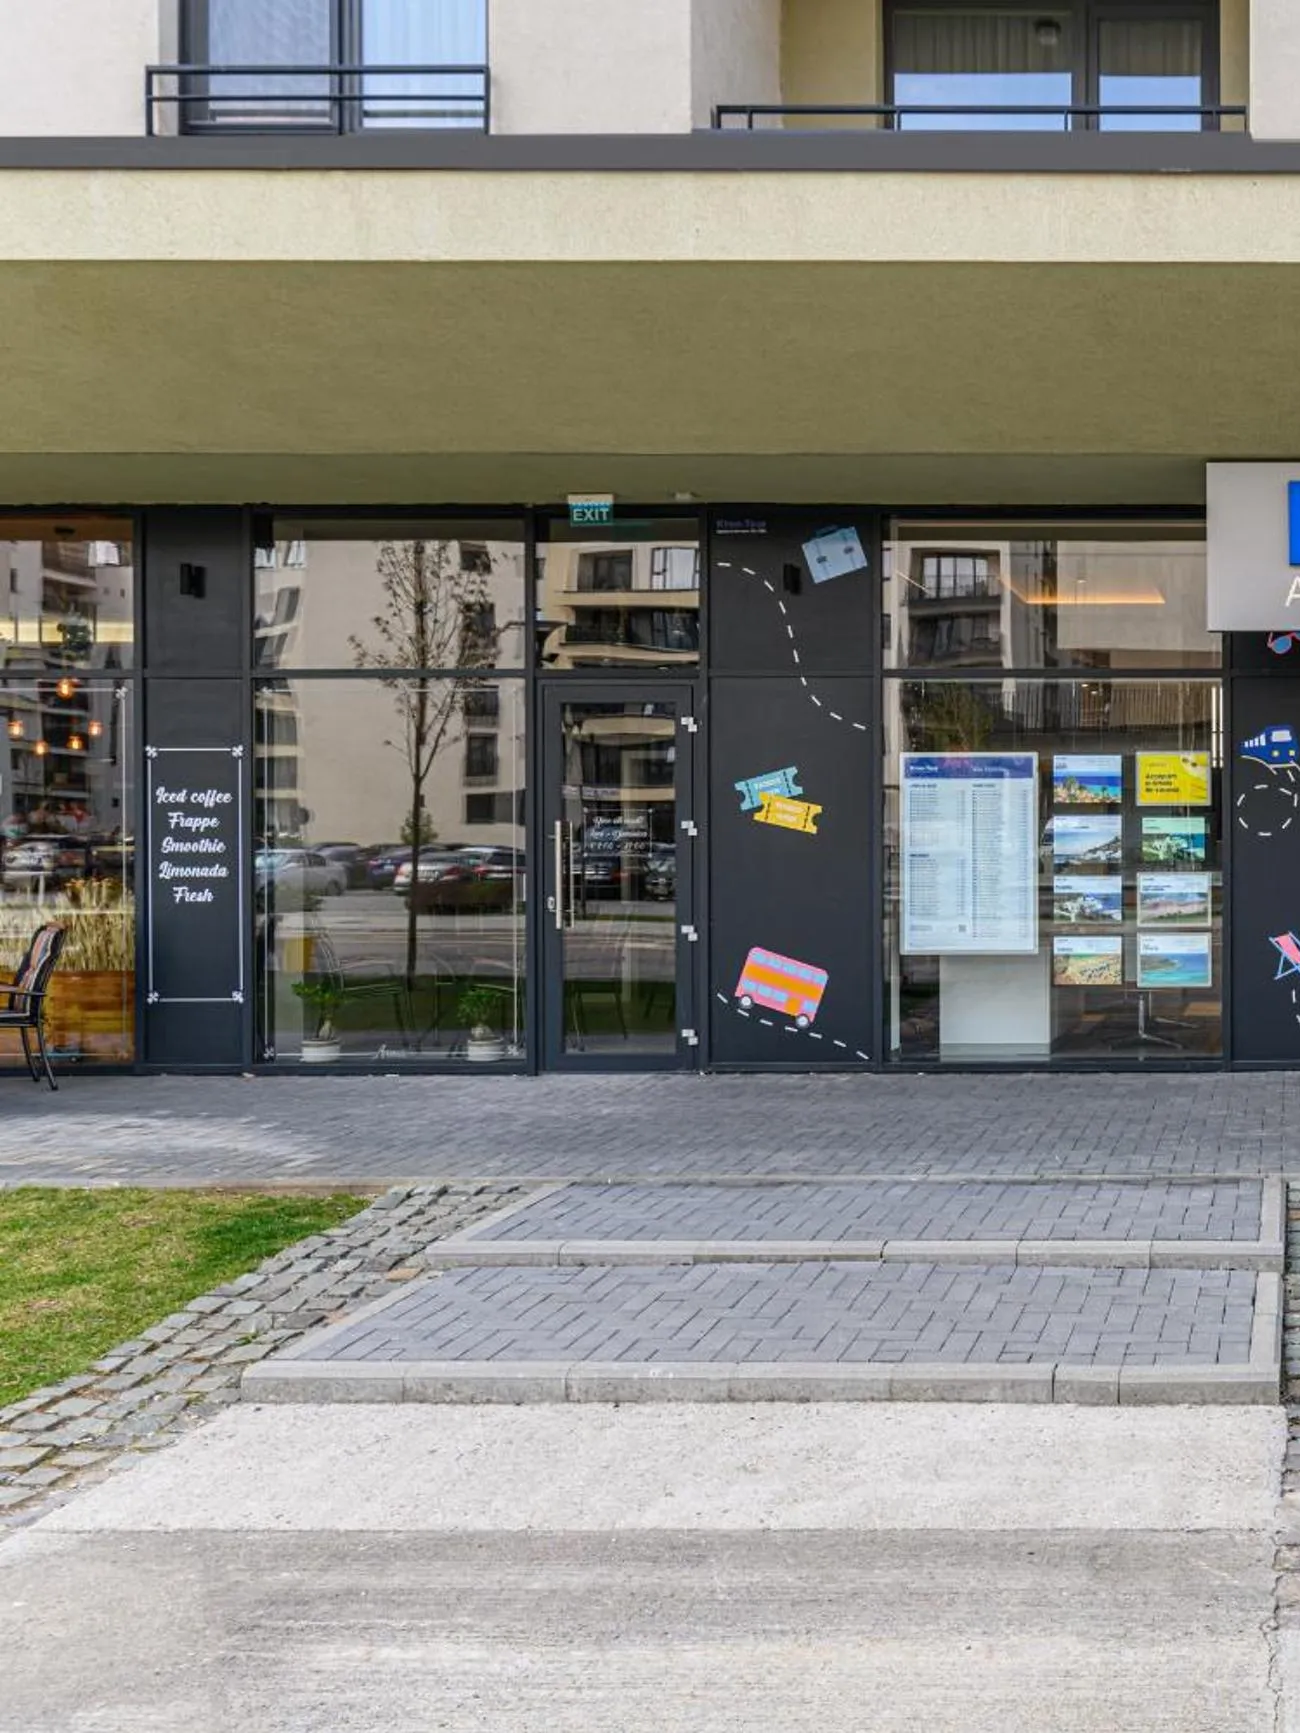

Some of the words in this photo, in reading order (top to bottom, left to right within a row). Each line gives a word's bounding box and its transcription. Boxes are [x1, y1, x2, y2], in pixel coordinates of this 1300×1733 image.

[573, 508, 609, 521] EXIT
[156, 786, 188, 804] Iced
[190, 789, 233, 808] coffee
[167, 811, 221, 832] Frappe
[161, 836, 226, 854] Smoothie
[159, 861, 229, 880] Limonada
[173, 886, 215, 904] Fresh
